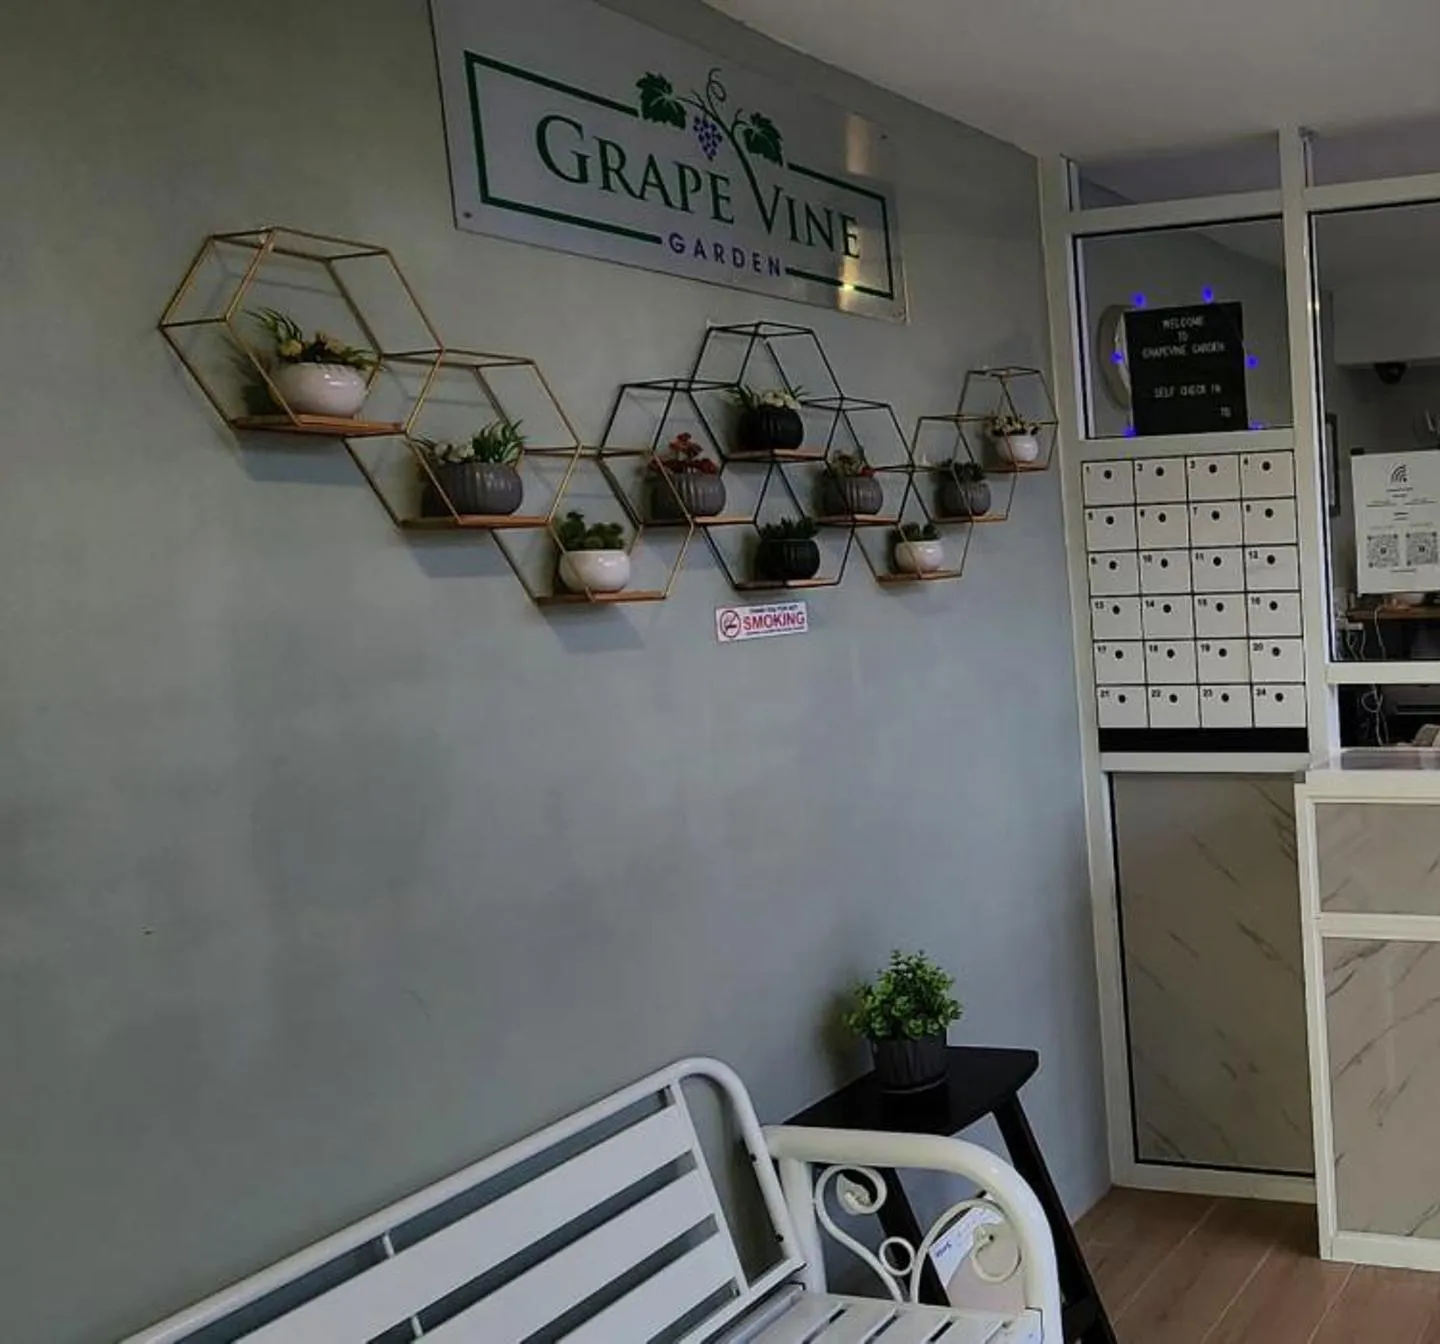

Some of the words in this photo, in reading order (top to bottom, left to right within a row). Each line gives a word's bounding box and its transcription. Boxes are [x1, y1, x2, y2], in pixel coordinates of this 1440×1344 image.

[535, 114, 734, 225] GRAPE
[736, 138, 860, 259] VINE
[668, 232, 782, 277] GARDEN
[743, 611, 805, 631] SMOKING
